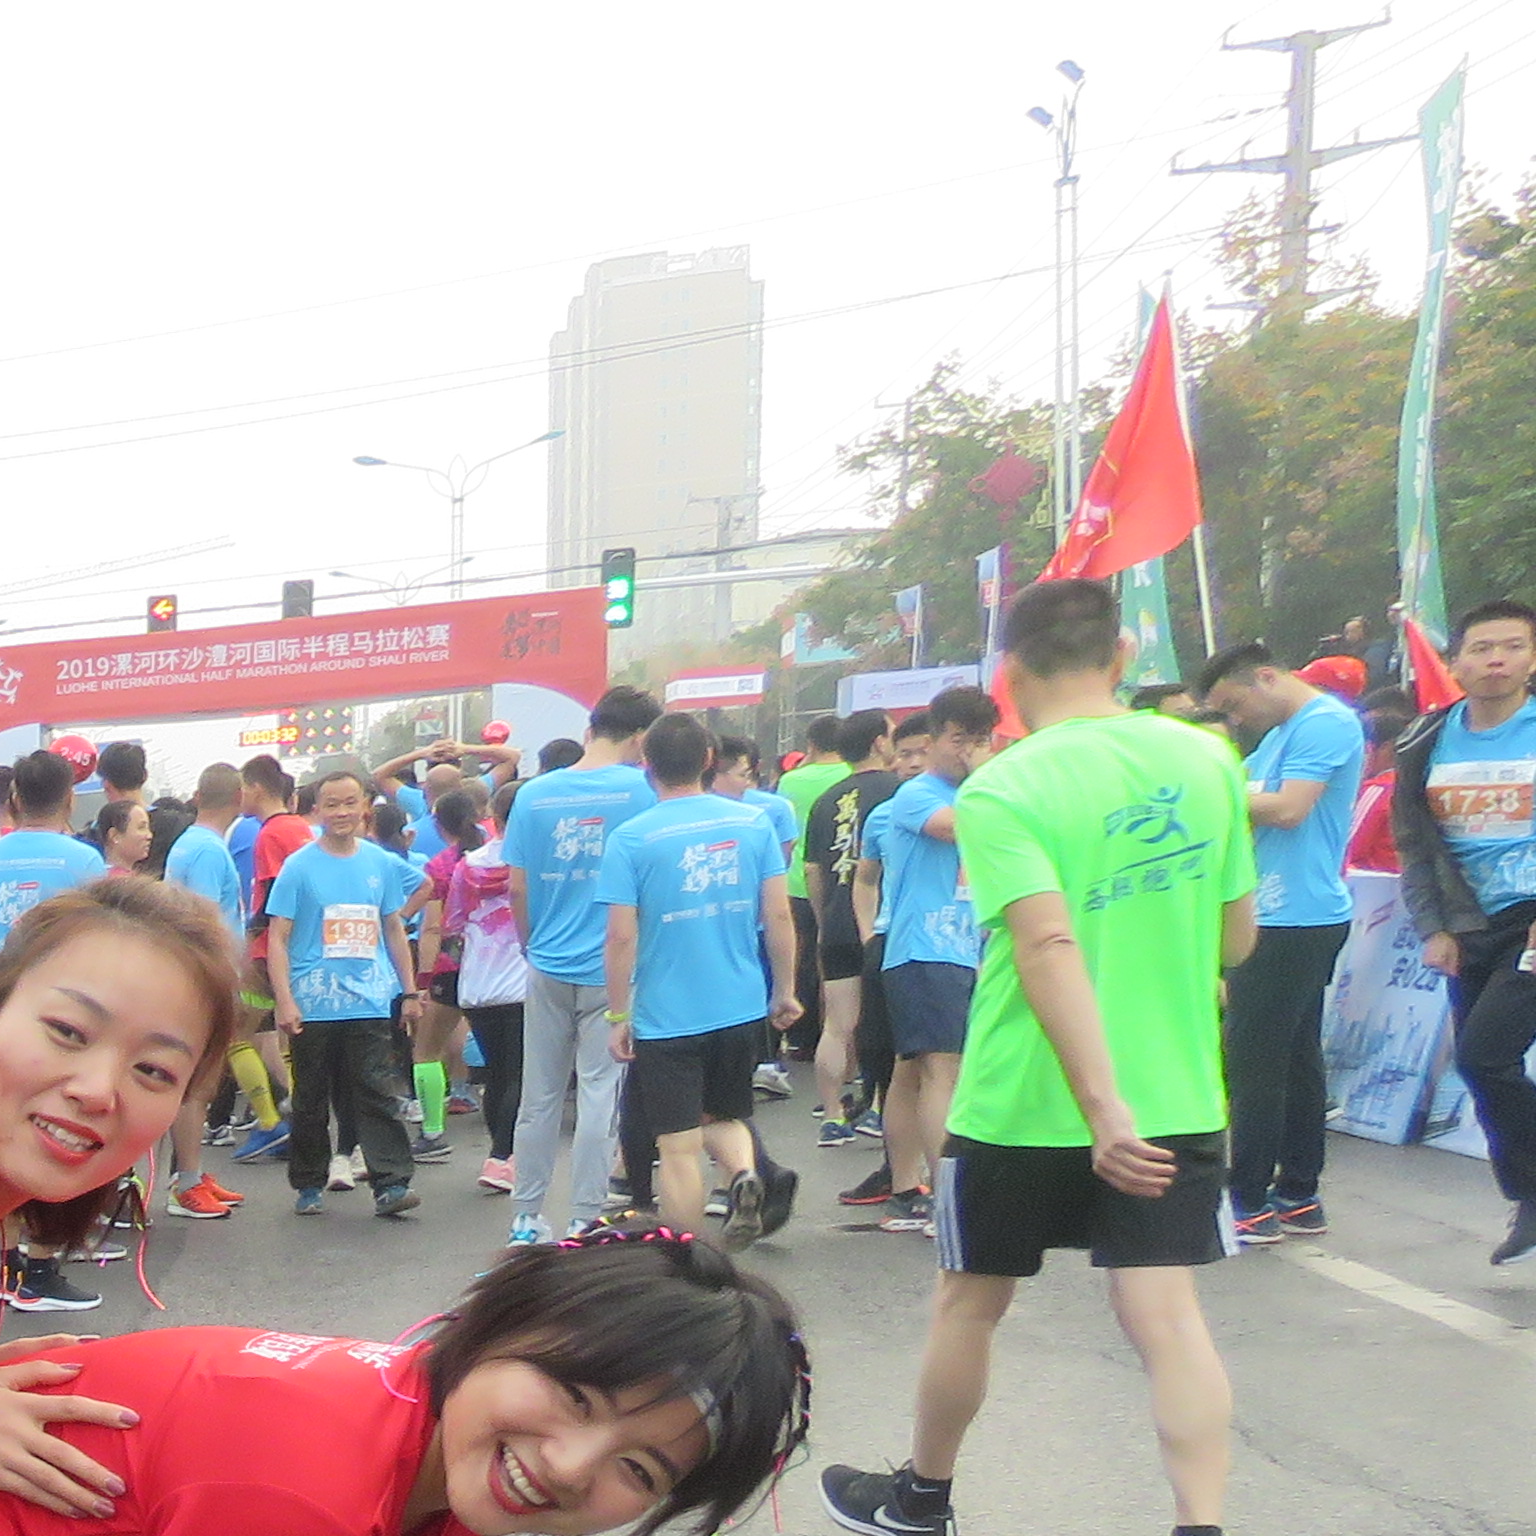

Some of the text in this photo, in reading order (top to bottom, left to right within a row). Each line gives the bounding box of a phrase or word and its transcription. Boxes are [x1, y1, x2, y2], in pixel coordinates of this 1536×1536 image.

[56, 649, 450, 695] LUOHE INTERNATIONAL HALF MARATHON AROUND SHALI RIVER
[1438, 788, 1521, 814] 1738
